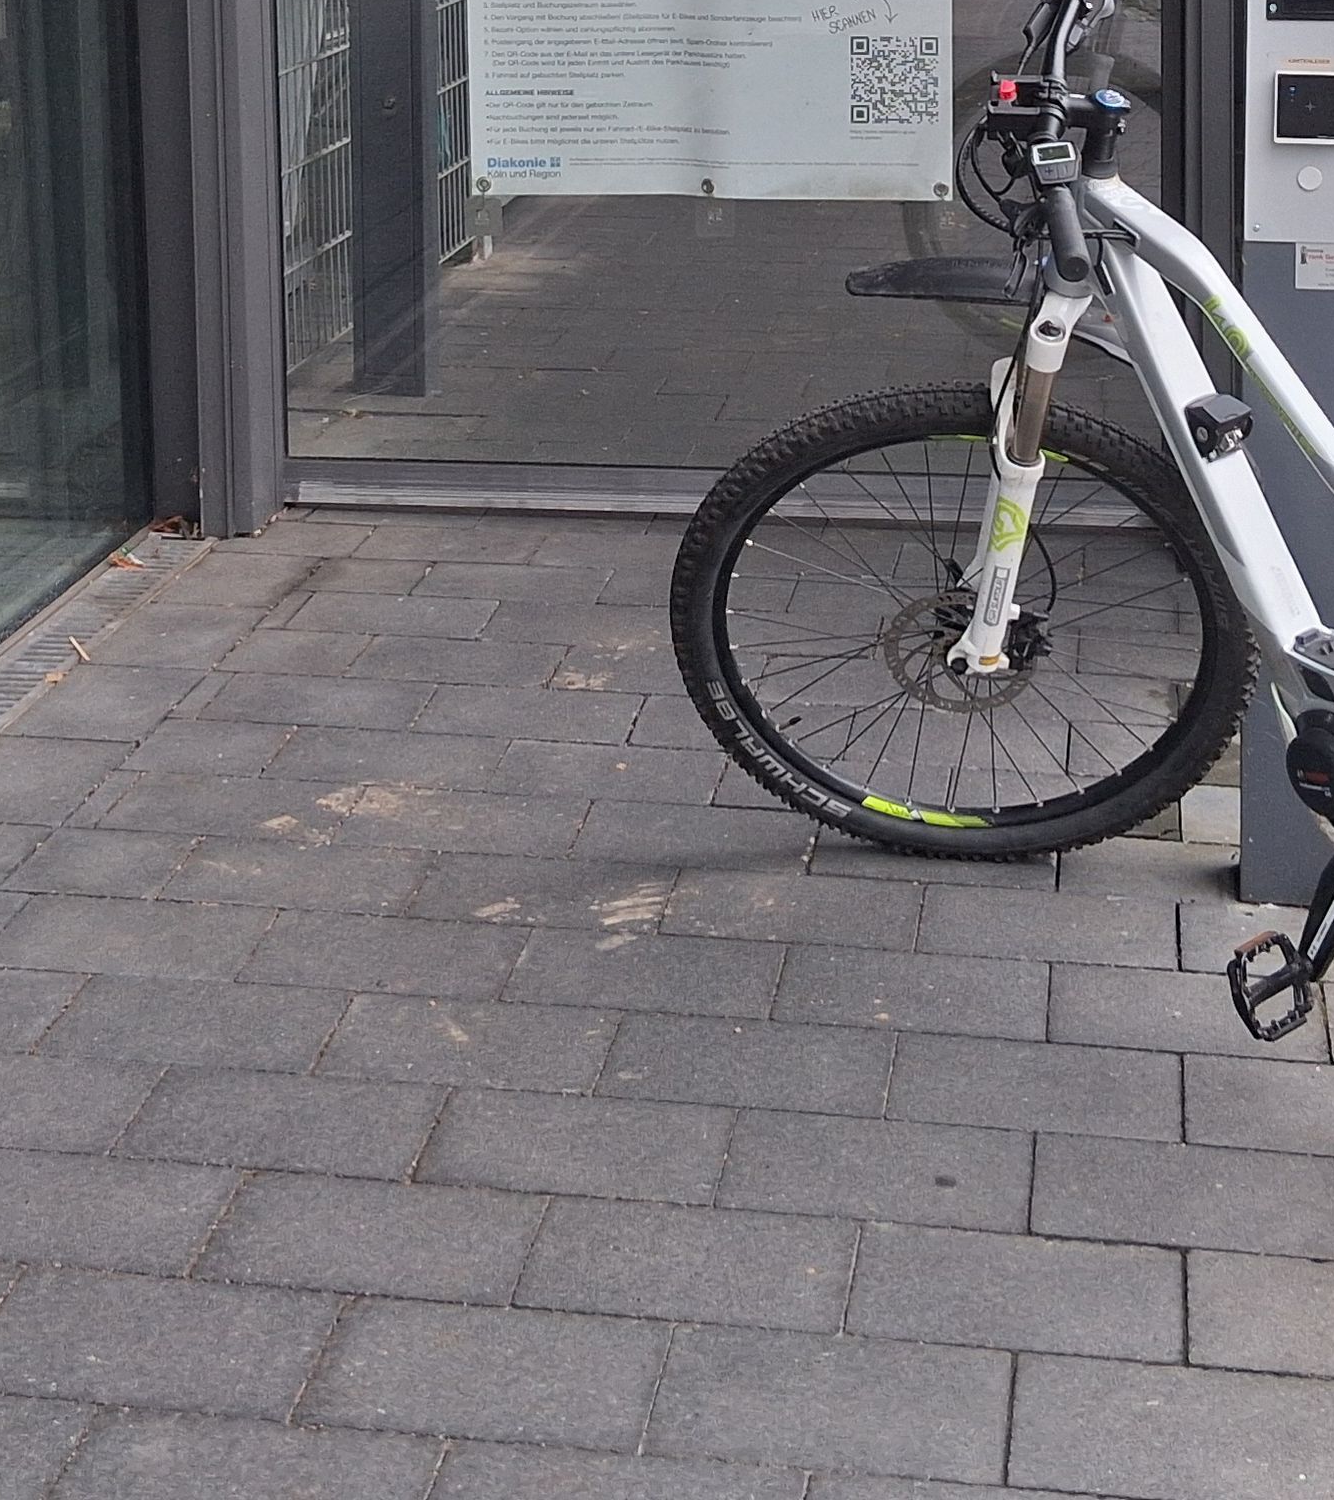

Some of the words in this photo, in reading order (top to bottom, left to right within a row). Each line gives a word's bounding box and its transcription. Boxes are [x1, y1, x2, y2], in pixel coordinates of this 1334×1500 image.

[811, 5, 839, 22] HIER
[829, 8, 876, 34] SCANNEN
[487, 157, 547, 168] Diakonie
[487, 169, 507, 178] Köln
[509, 169, 527, 178] und
[529, 169, 561, 180] Region
[706, 680, 852, 818] SCHWALBE
